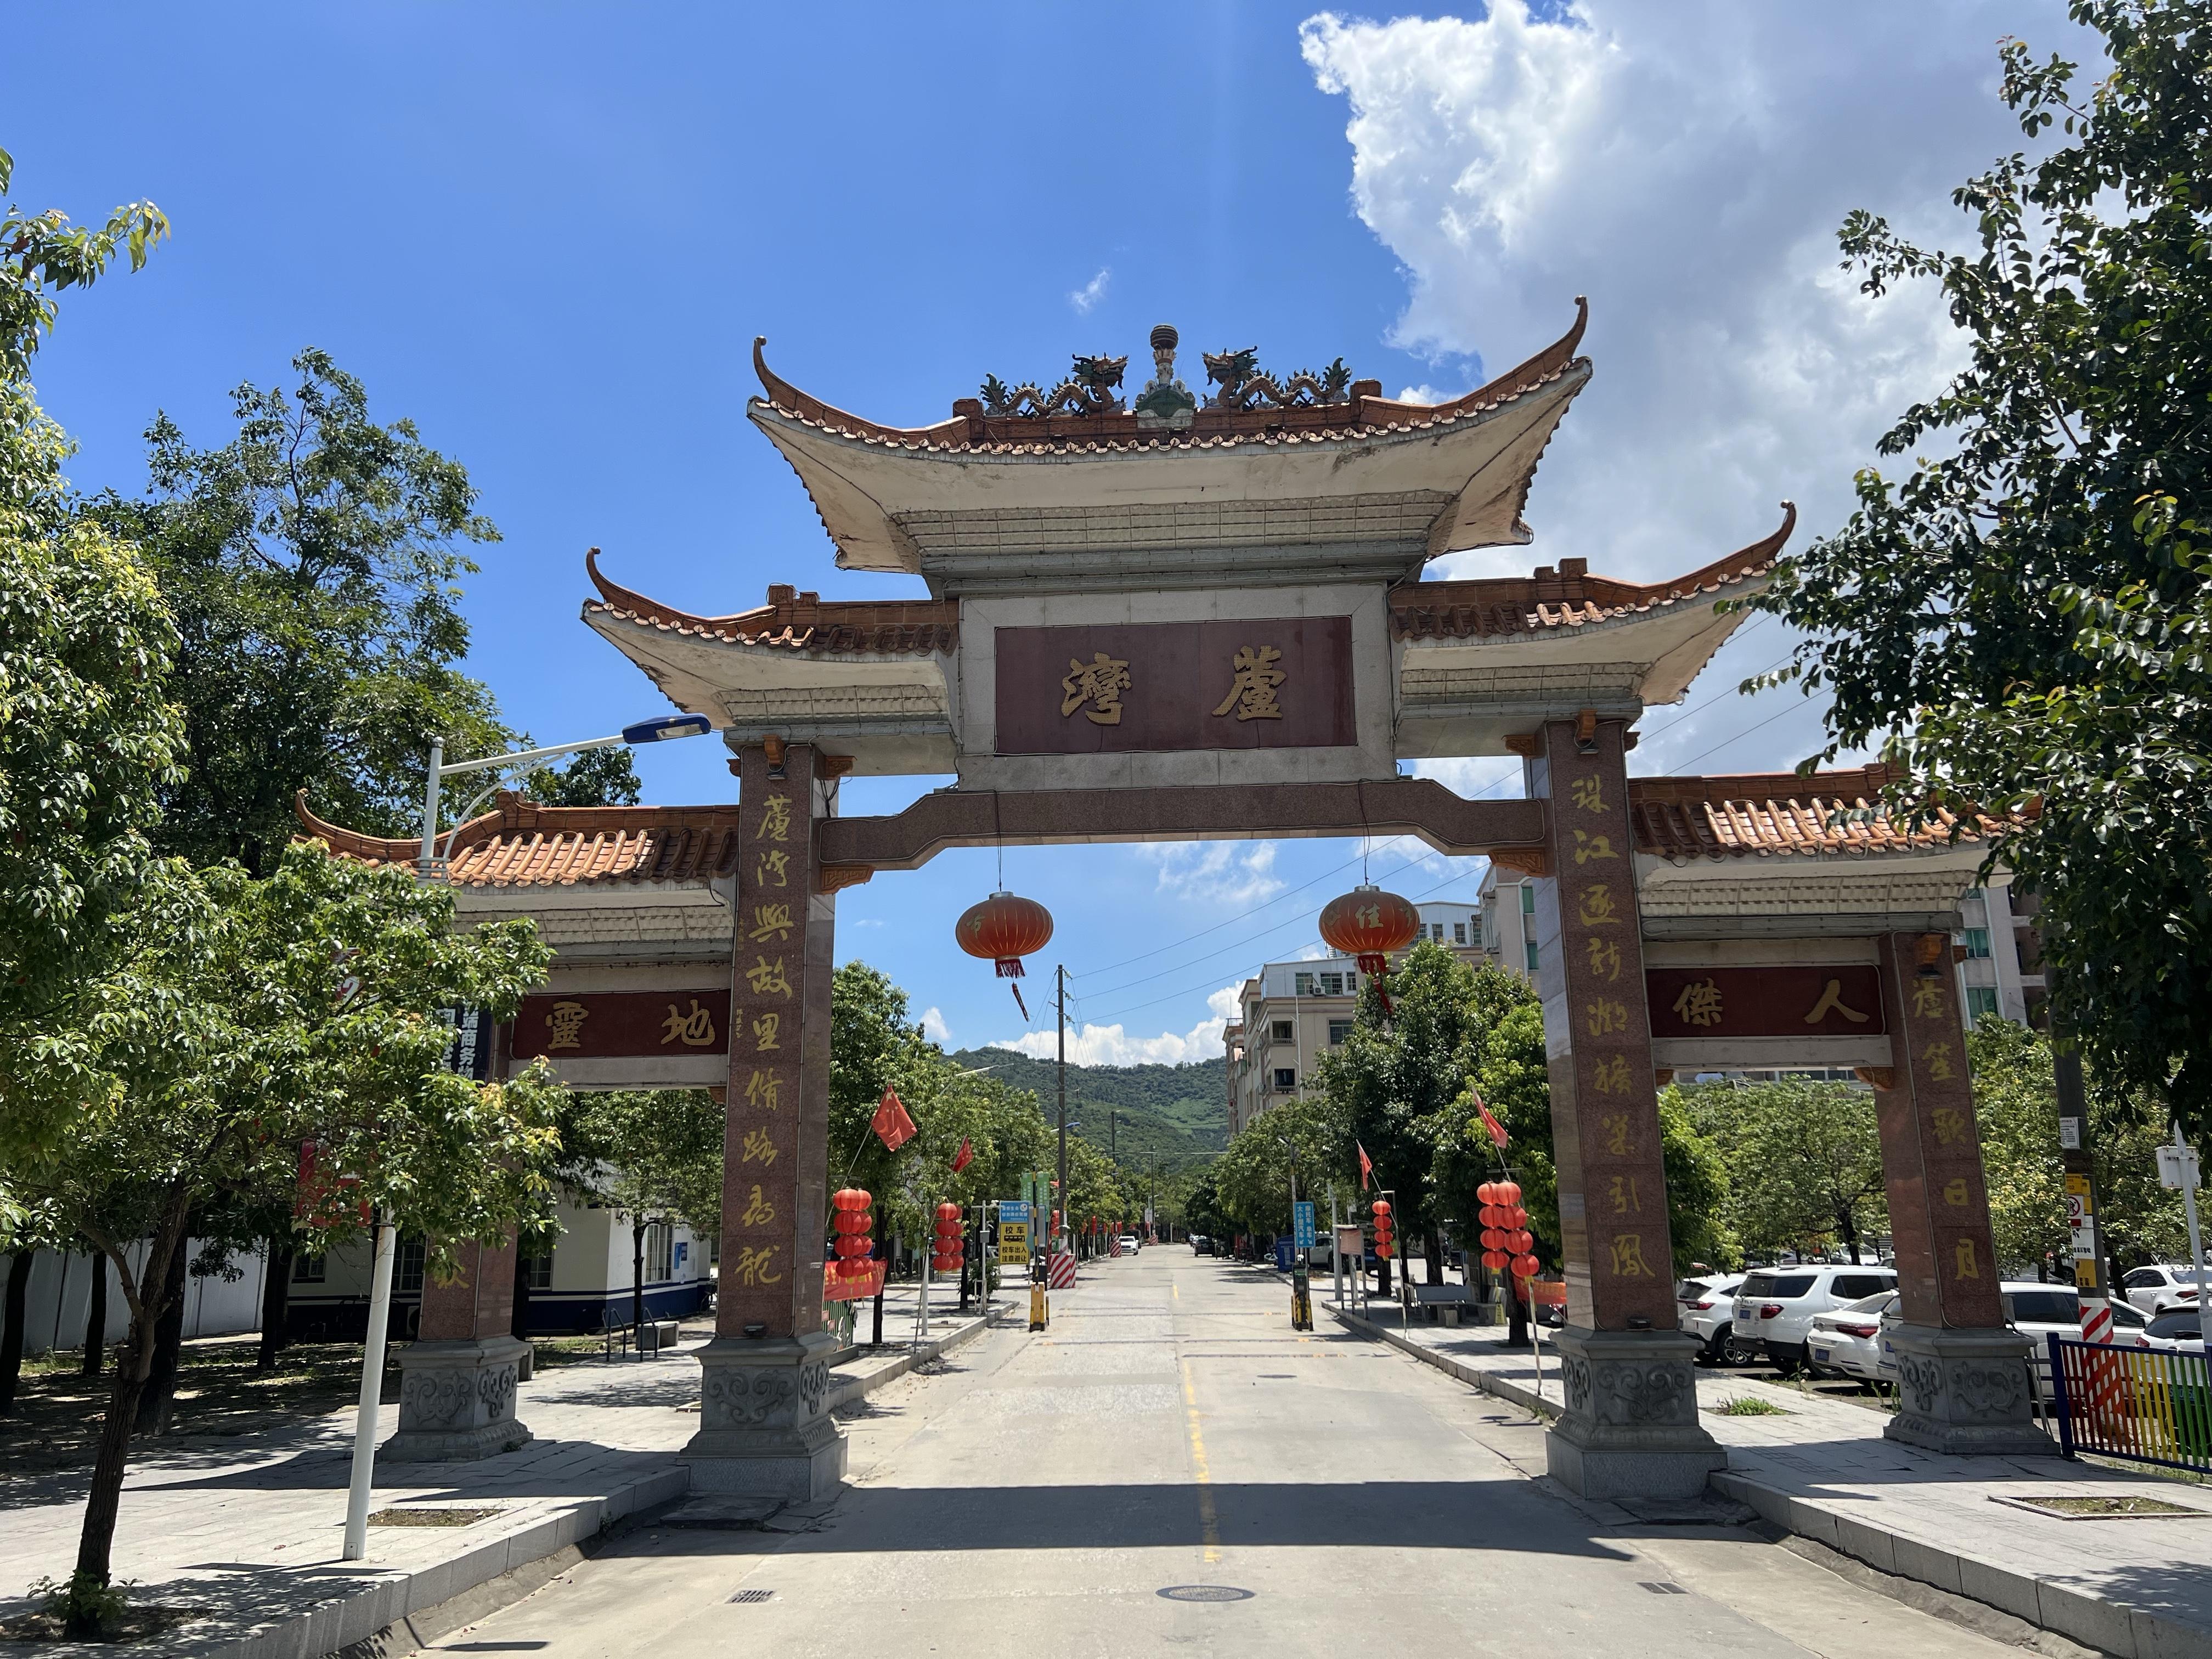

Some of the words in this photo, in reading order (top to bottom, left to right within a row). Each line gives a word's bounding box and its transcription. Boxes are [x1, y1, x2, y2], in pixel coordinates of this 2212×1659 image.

[545, 999, 716, 1050] 地靈
[1672, 977, 1870, 1027] 人傑
[1005, 1226, 1024, 1234] 校车
